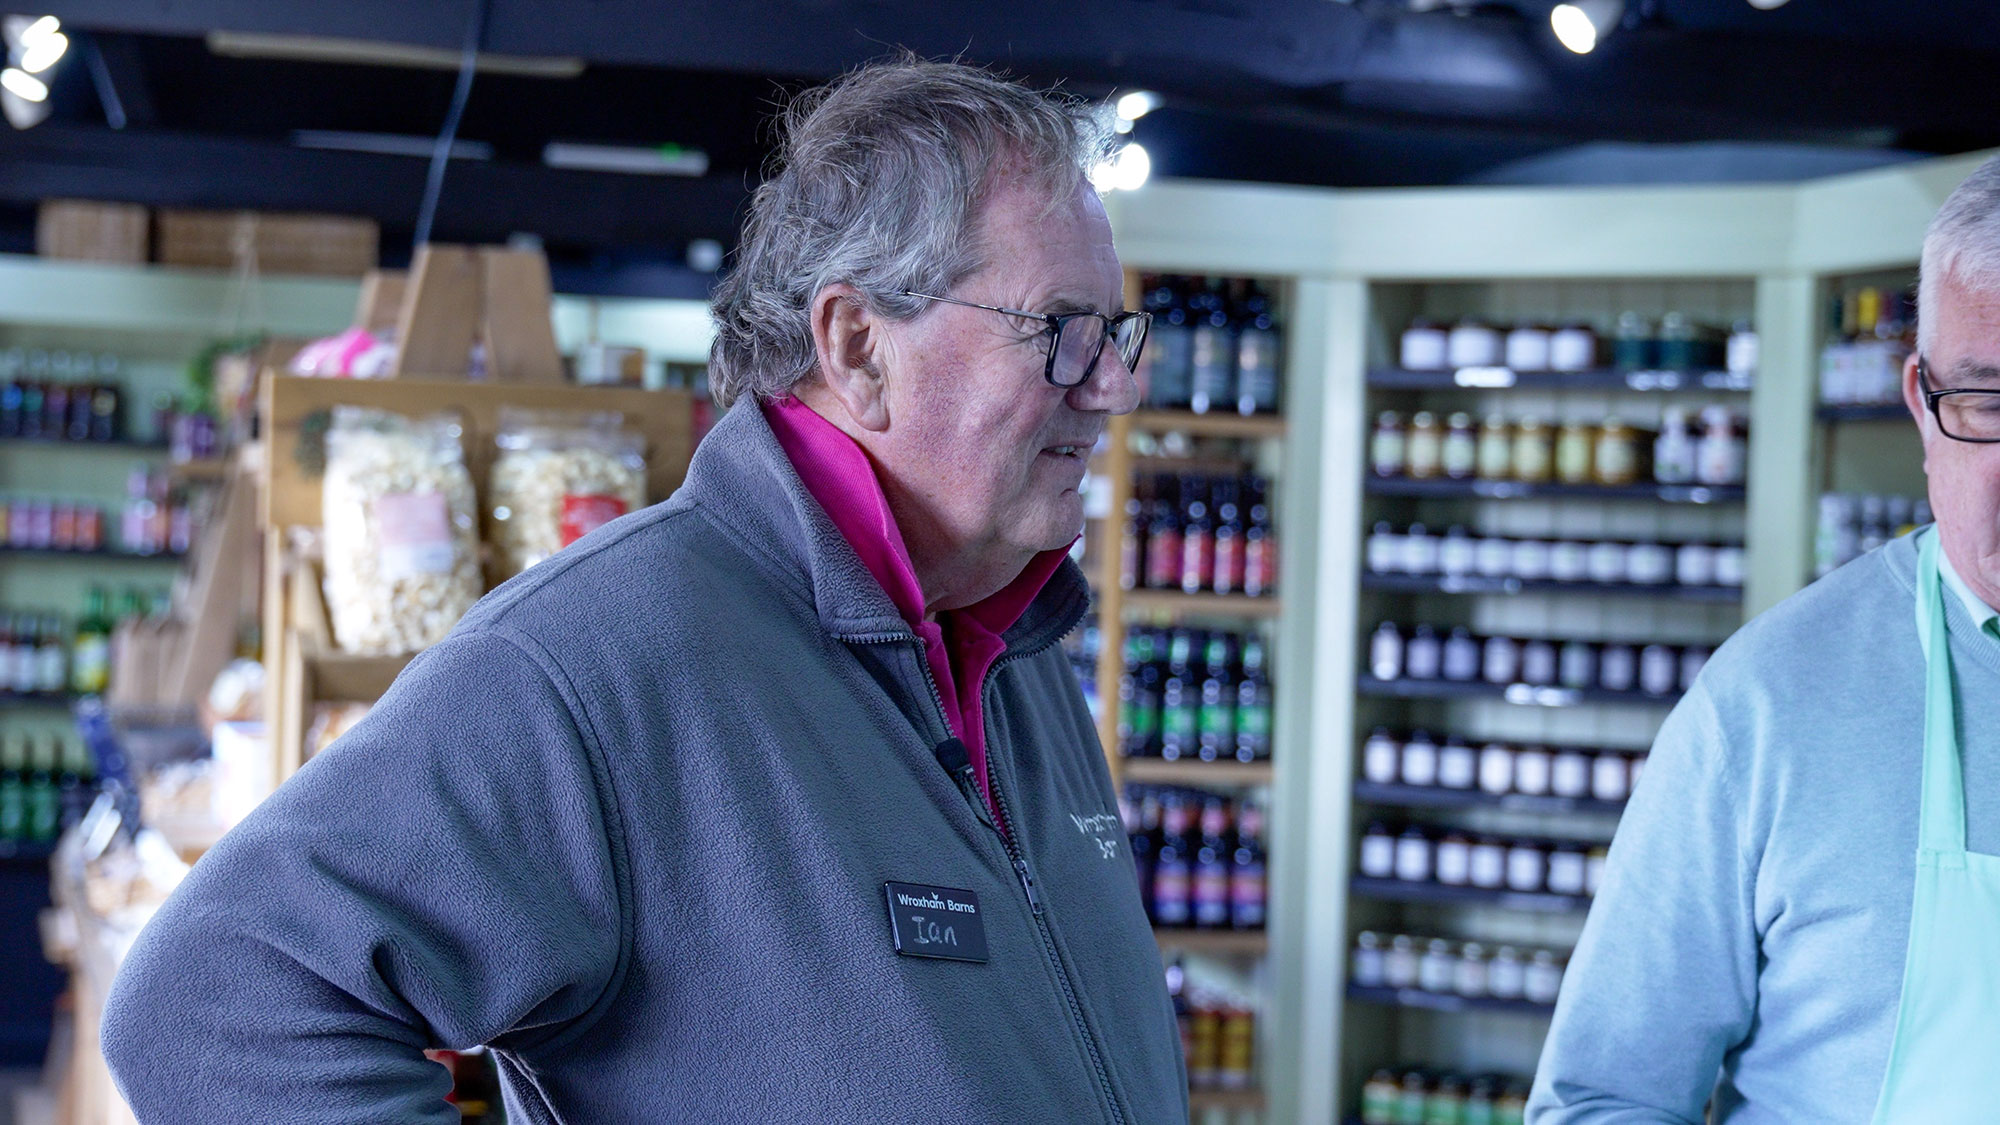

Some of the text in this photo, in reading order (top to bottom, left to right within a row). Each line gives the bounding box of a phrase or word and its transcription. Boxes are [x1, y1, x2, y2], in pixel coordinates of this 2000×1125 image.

[897, 893, 975, 914] Wroxham Barns
[911, 915, 957, 946] Ian
